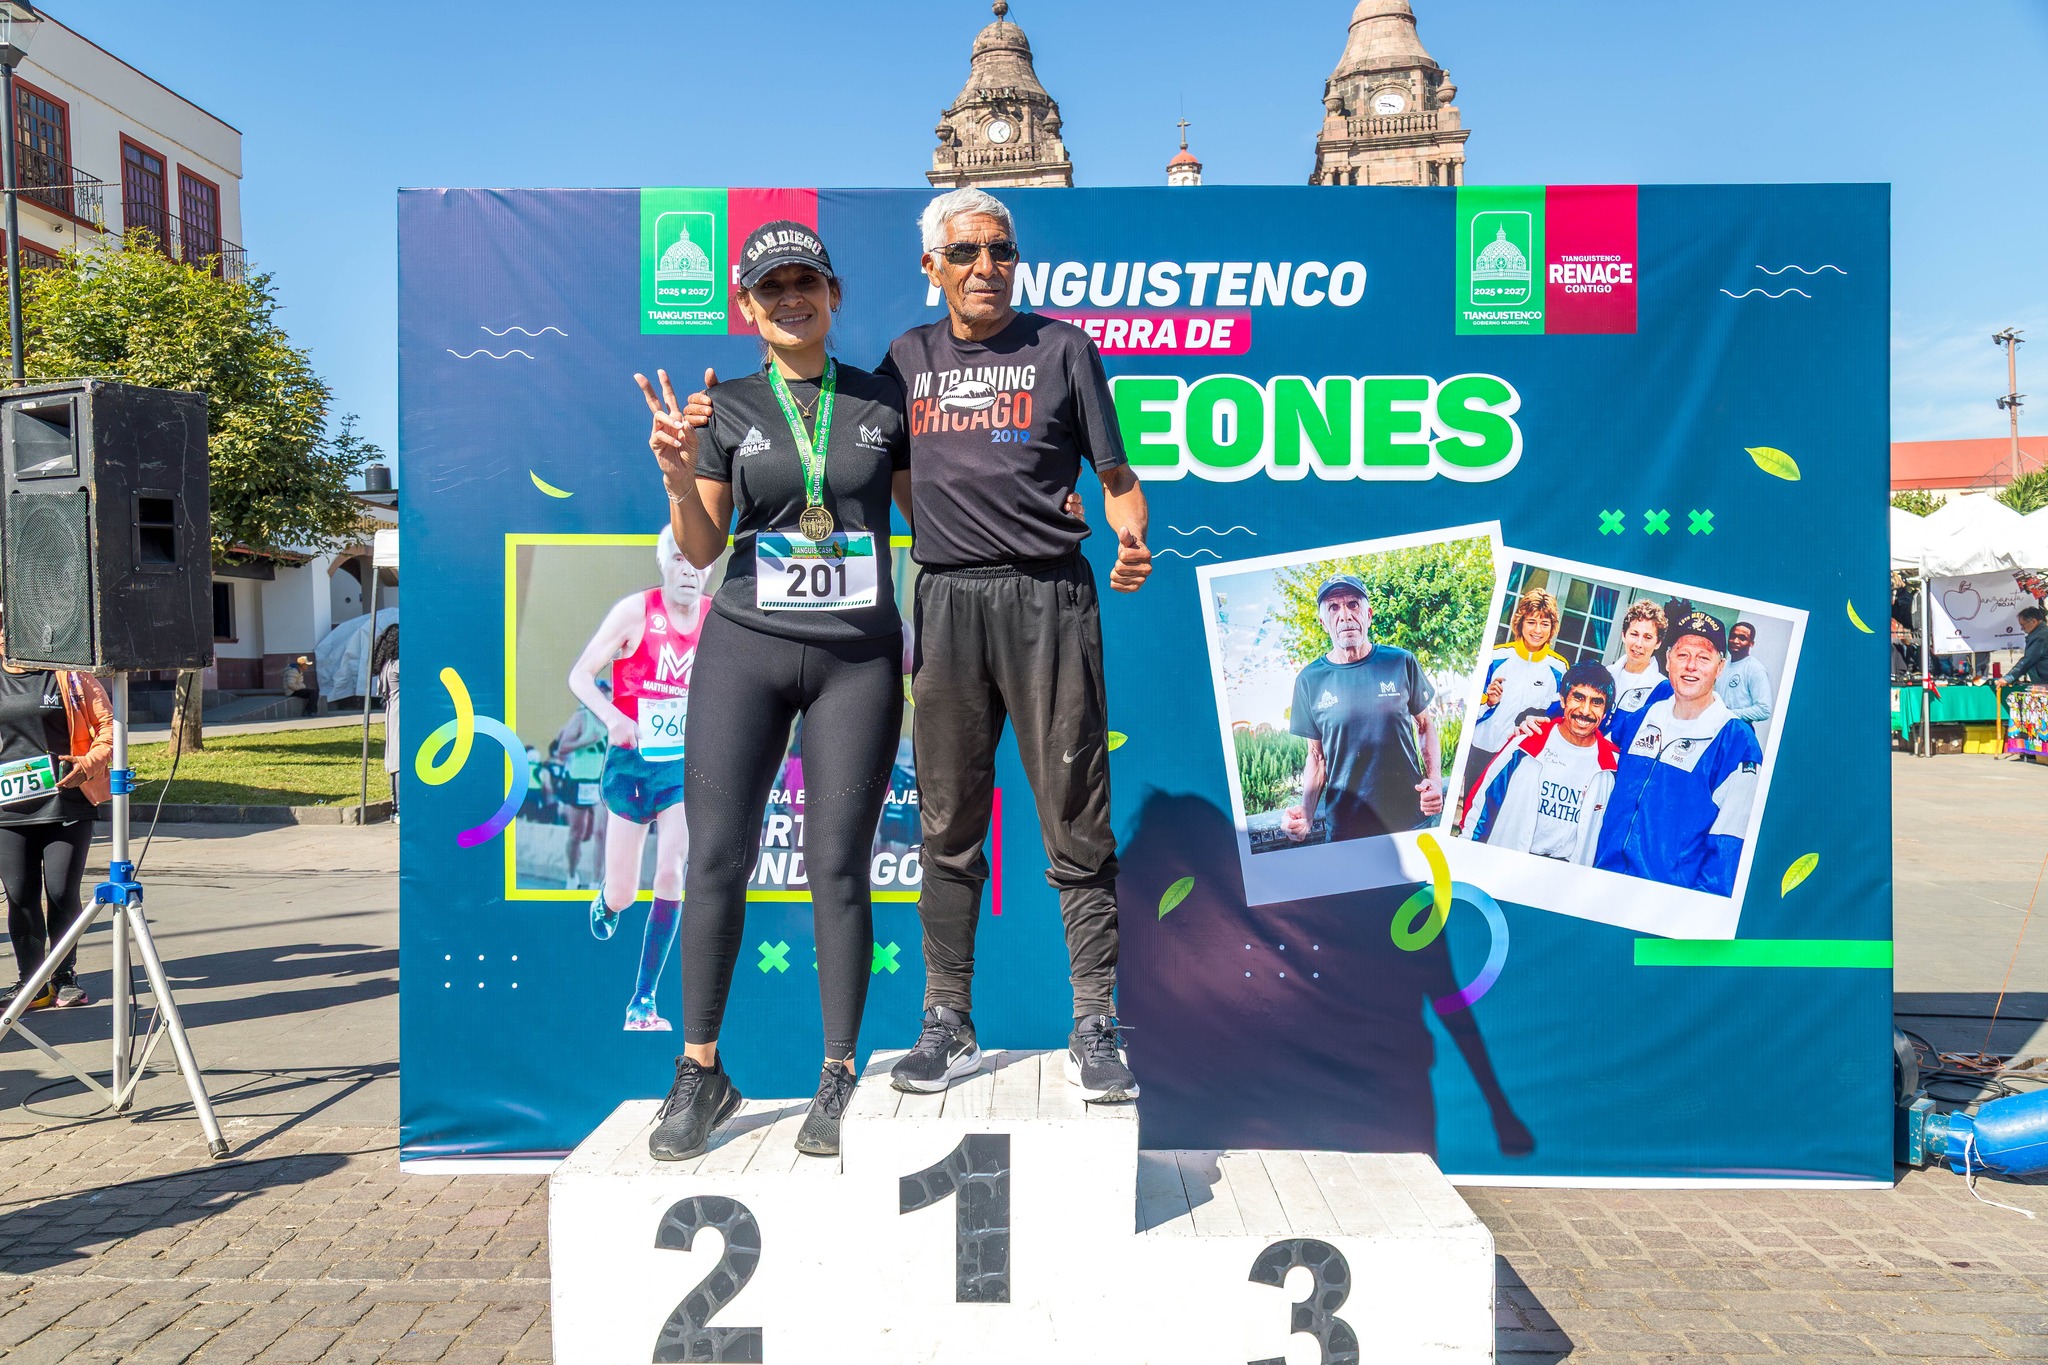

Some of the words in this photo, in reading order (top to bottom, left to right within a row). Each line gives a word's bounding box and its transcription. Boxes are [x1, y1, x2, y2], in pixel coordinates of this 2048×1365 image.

[747, 232, 778, 262] SAN
[777, 229, 822, 256] DIEGO
[767, 246, 790, 255] Original
[921, 261, 1367, 307] NGUISTENCO
[1549, 263, 1633, 284] RENACE
[659, 288, 680, 296] 2025
[688, 288, 709, 296] 2027
[1474, 288, 1496, 296] 2025
[1504, 288, 1526, 296] 2027
[1565, 284, 1612, 293] CONTIGO
[647, 311, 726, 320] TIANGUISTENCO
[1463, 311, 1543, 320] TIANGUISTENCO
[1064, 318, 1178, 349] ERRA
[1184, 318, 1235, 349] DE
[912, 371, 933, 400] IN
[938, 364, 1036, 396] TRAINING
[911, 391, 1033, 436] CHICAGO
[990, 429, 1031, 444] 2019
[1112, 373, 1524, 482] EONES
[792, 546, 817, 554] TIANGUIS
[786, 564, 847, 598] 201
[0, 773, 41, 797] 075
[1541, 780, 1582, 805] STON
[899, 1133, 1011, 1304] 1
[651, 1194, 763, 1365] 2
[1247, 1238, 1360, 1365] 3
